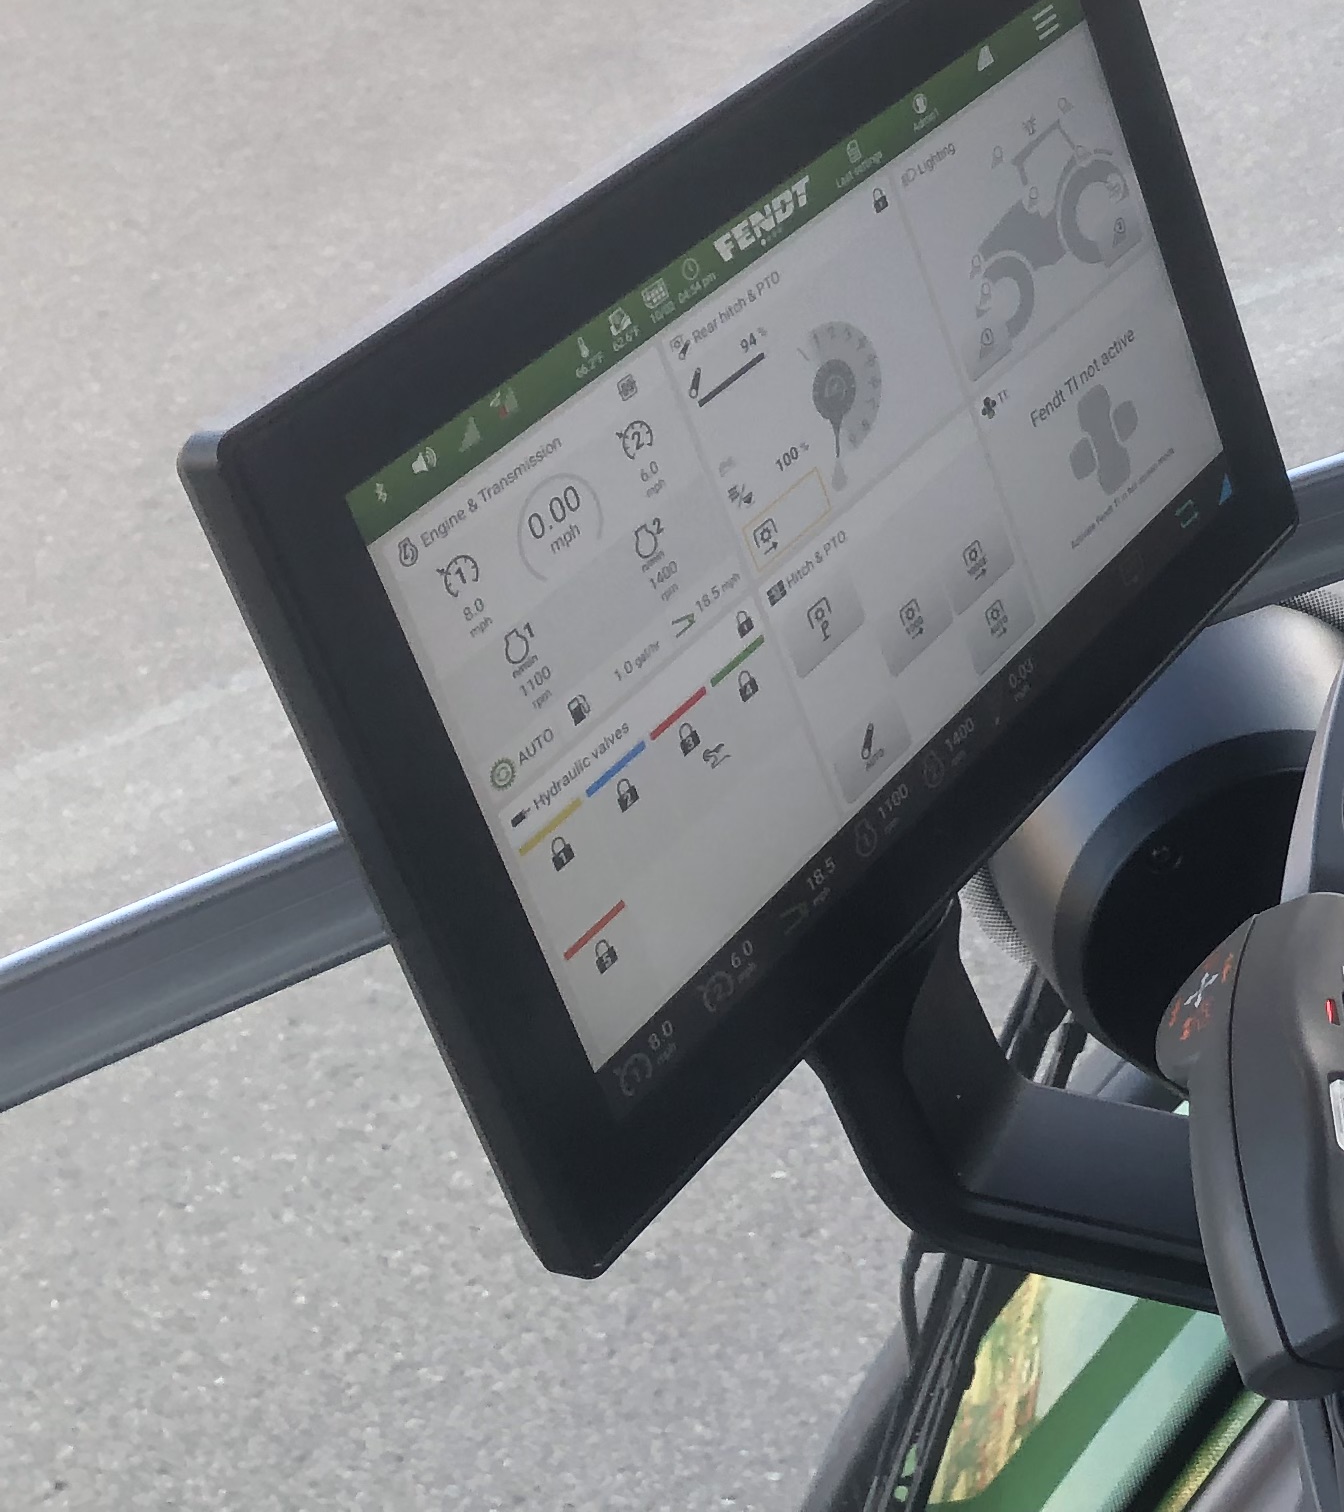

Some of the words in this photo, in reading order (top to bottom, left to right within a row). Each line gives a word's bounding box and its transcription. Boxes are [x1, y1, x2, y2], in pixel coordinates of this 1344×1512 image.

[917, 143, 956, 176] Lighting
[713, 175, 810, 262] FENDT
[692, 318, 718, 344] Rear
[719, 297, 746, 324] hitch
[748, 290, 757, 303] &
[755, 271, 781, 296] PTO
[739, 333, 757, 353] 94
[1030, 388, 1066, 428] Fendt
[1064, 376, 1079, 397] TI
[1080, 359, 1100, 384] not
[1100, 329, 1135, 367] active
[775, 446, 799, 472] 100
[420, 506, 467, 548] Engine
[468, 498, 478, 513] &
[477, 437, 563, 504] Transmission
[528, 486, 581, 539] 0.00
[550, 523, 581, 554] mph
[649, 560, 678, 590] 1400
[786, 558, 815, 589] Hitch
[815, 551, 823, 564] &
[823, 530, 847, 557] PTO
[463, 598, 485, 622] 8.0
[469, 616, 493, 638] mph
[519, 666, 552, 697] 1100
[517, 728, 555, 766] AUTO
[533, 756, 591, 811] Hydraulic
[591, 722, 630, 758] valves
